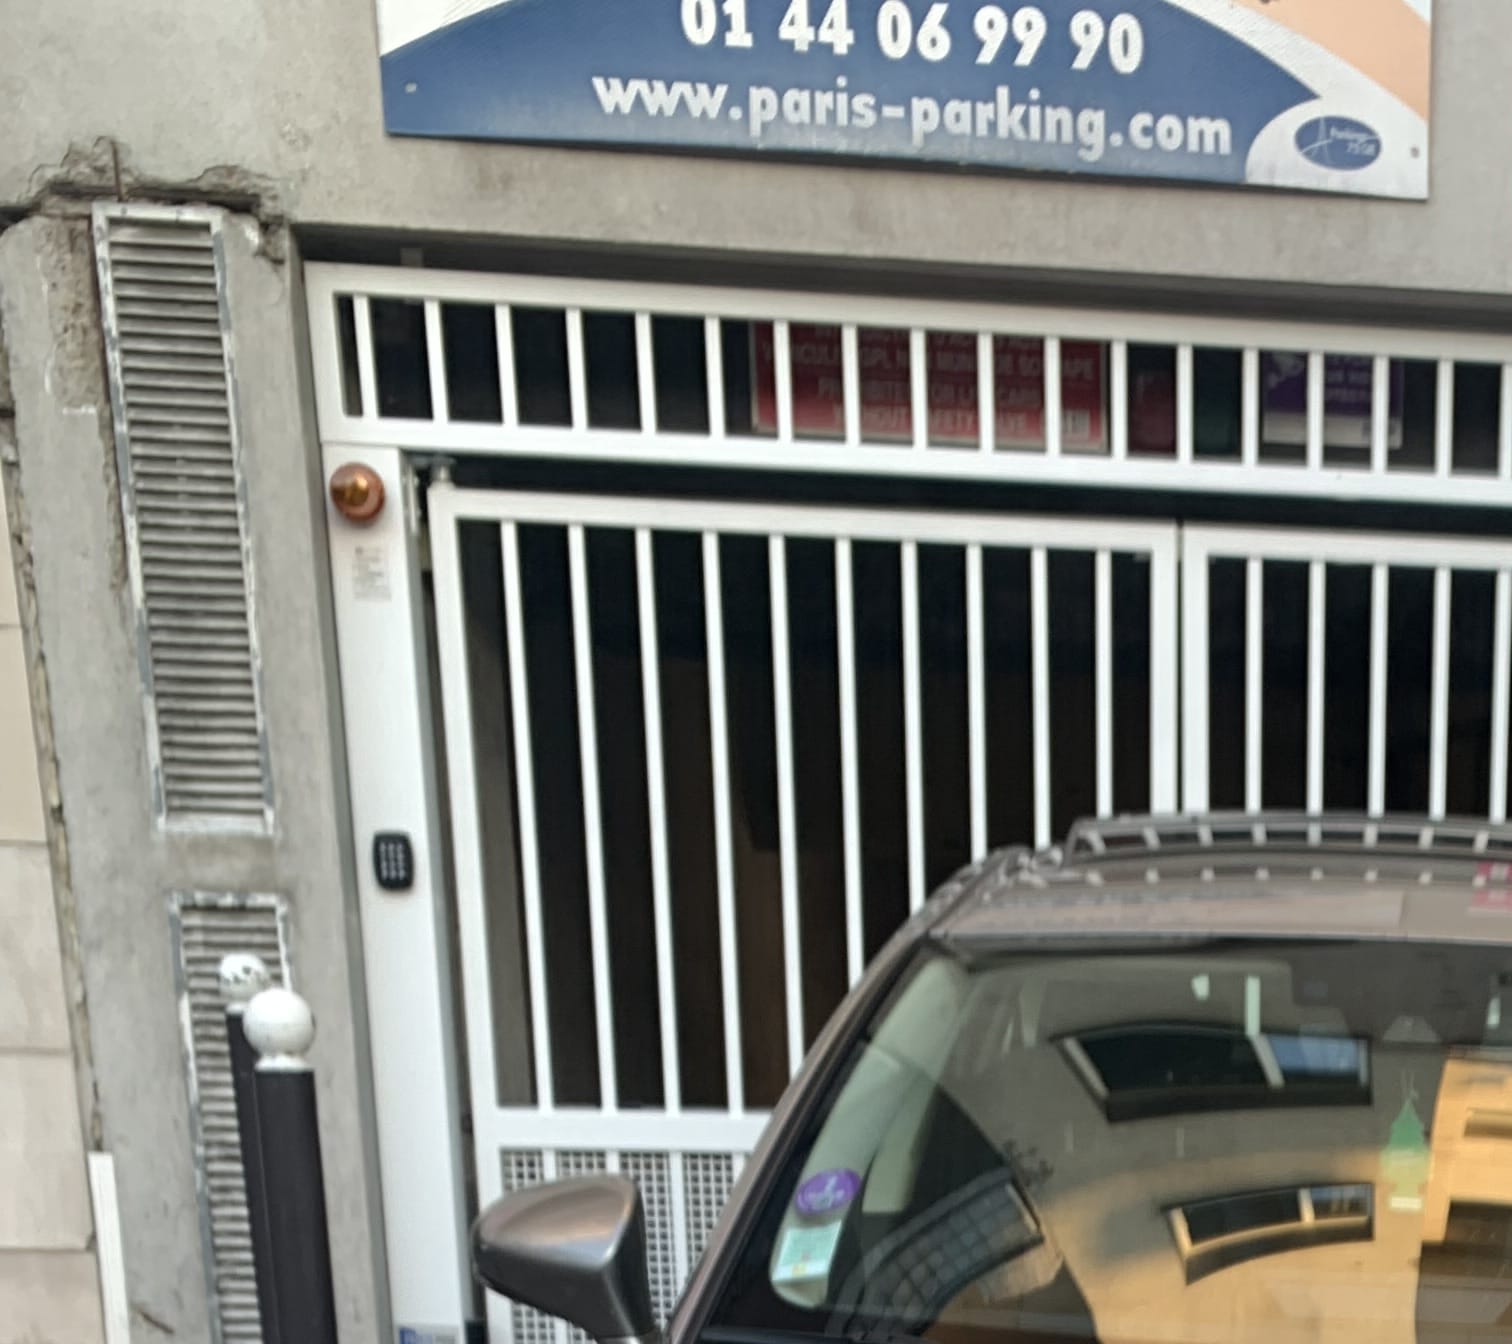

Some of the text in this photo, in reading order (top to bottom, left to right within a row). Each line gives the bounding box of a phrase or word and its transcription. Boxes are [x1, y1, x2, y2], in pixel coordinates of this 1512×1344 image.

[681, 0, 1144, 74] 01 44 06 99 90
[592, 77, 1231, 160] www.paris-parking.com
